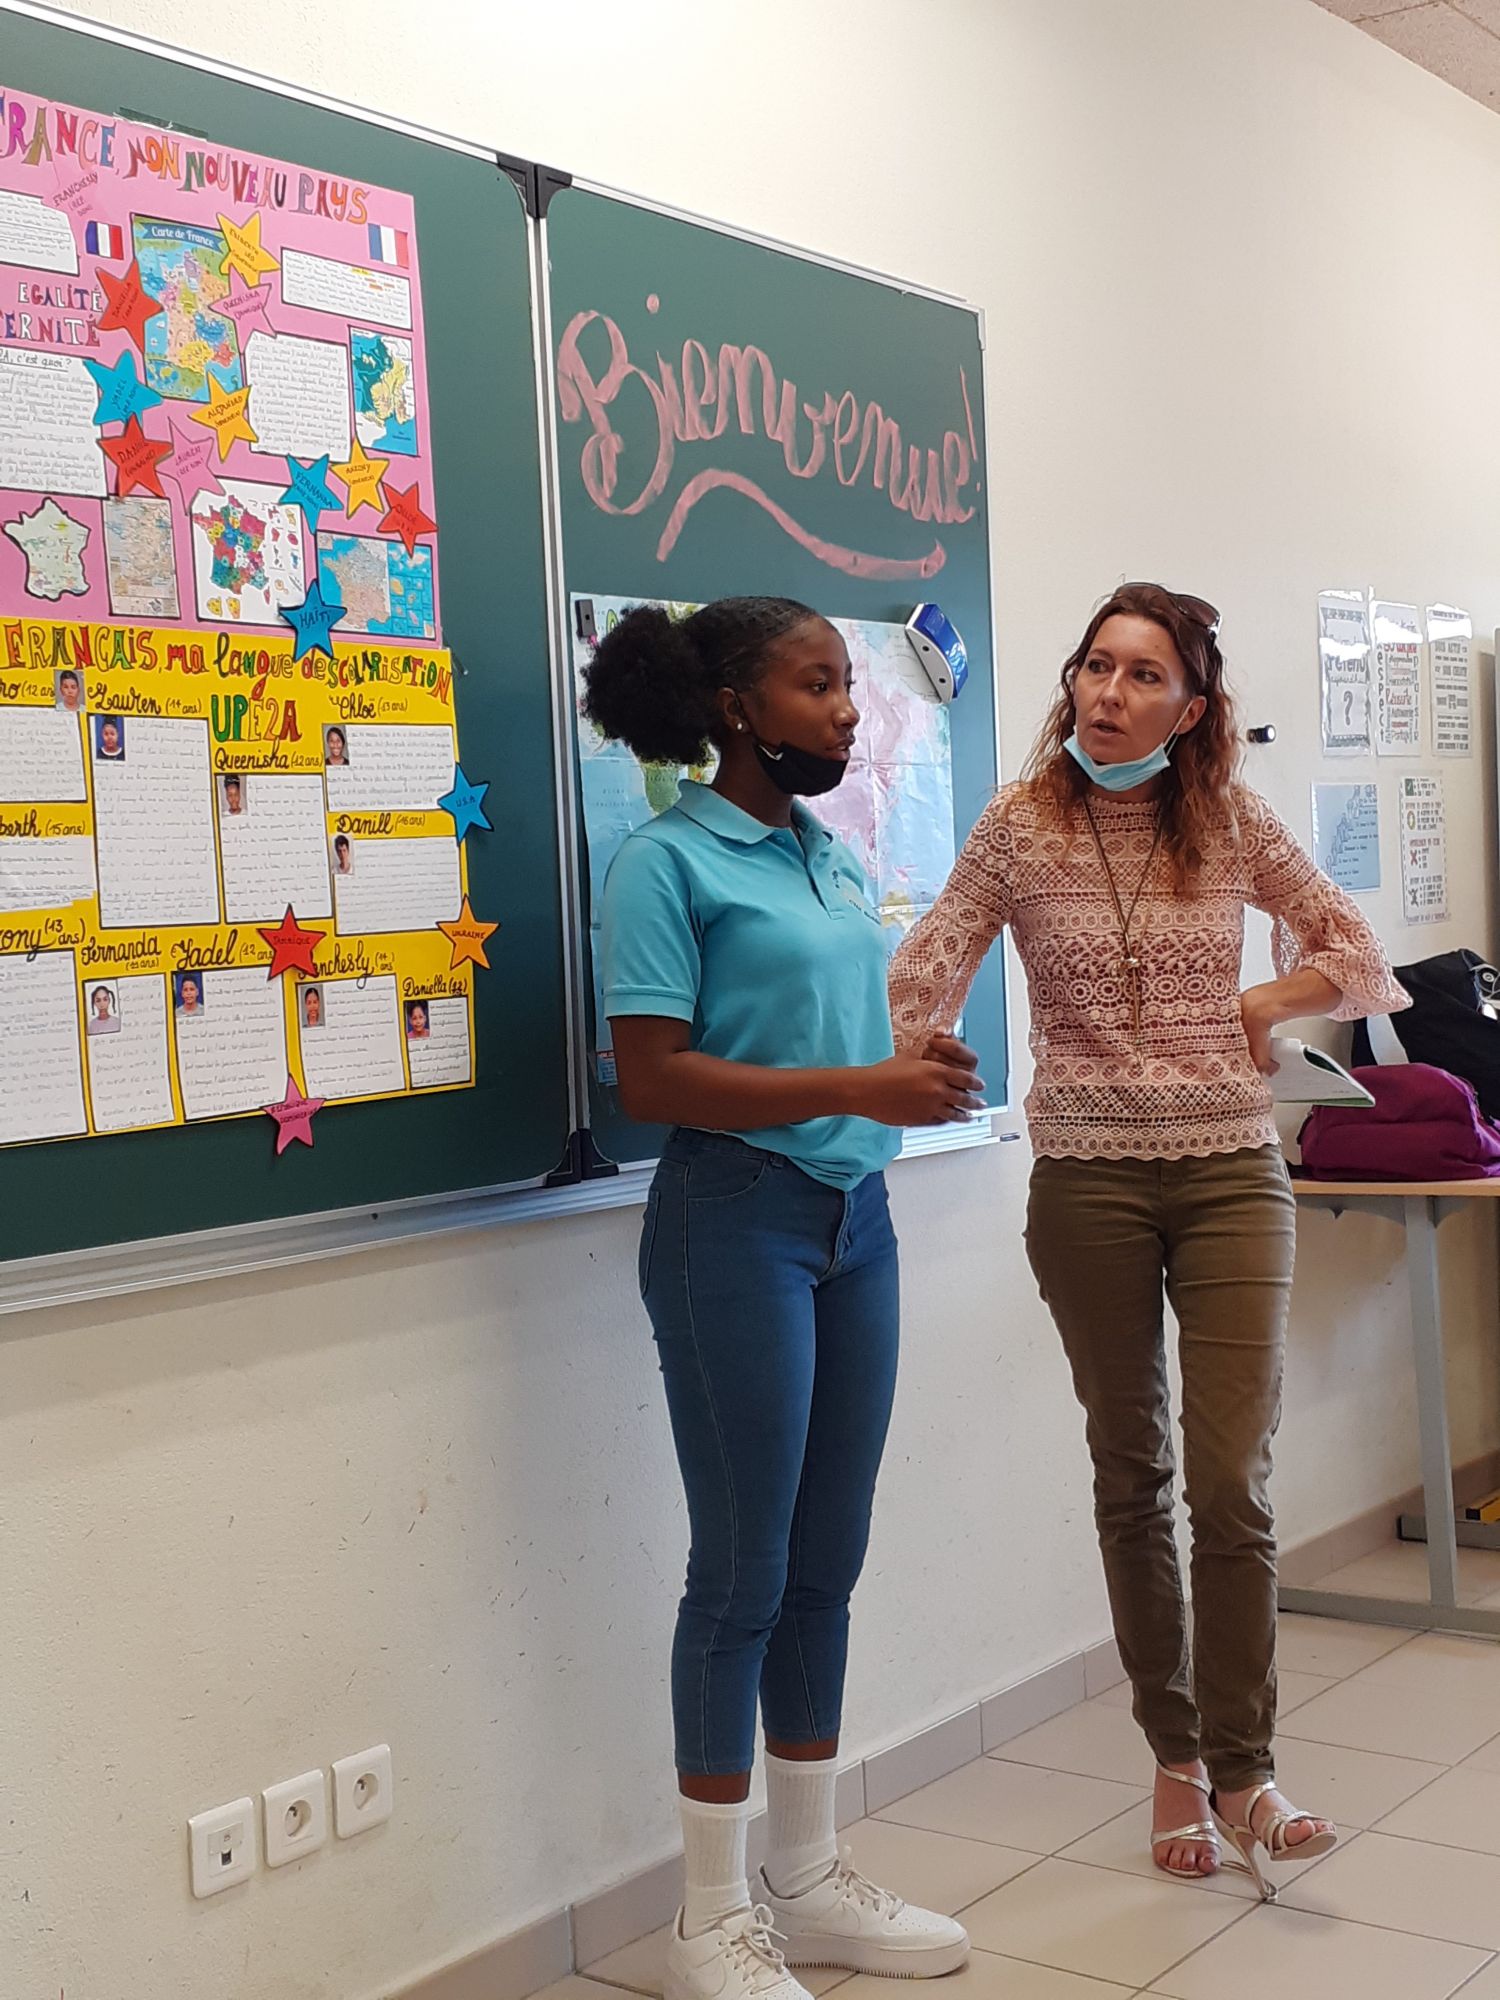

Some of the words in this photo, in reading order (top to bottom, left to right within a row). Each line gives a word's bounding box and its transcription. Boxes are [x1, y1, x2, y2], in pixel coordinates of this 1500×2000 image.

[0, 91, 119, 175] RANCE,
[177, 150, 287, 210] NOUVEAU
[289, 173, 370, 225] PAYS
[151, 226, 174, 239] Carte
[175, 229, 184, 239] de
[186, 231, 215, 247] France
[0, 309, 100, 346] ERNITÉ
[17, 352, 38, 365] c'est
[166, 643, 209, 674] ma
[214, 632, 294, 700] langue
[87, 682, 162, 716] Lauren
[214, 737, 290, 770] Queenisha
[81, 932, 161, 966] Fernanda
[403, 974, 448, 998] Daniella
